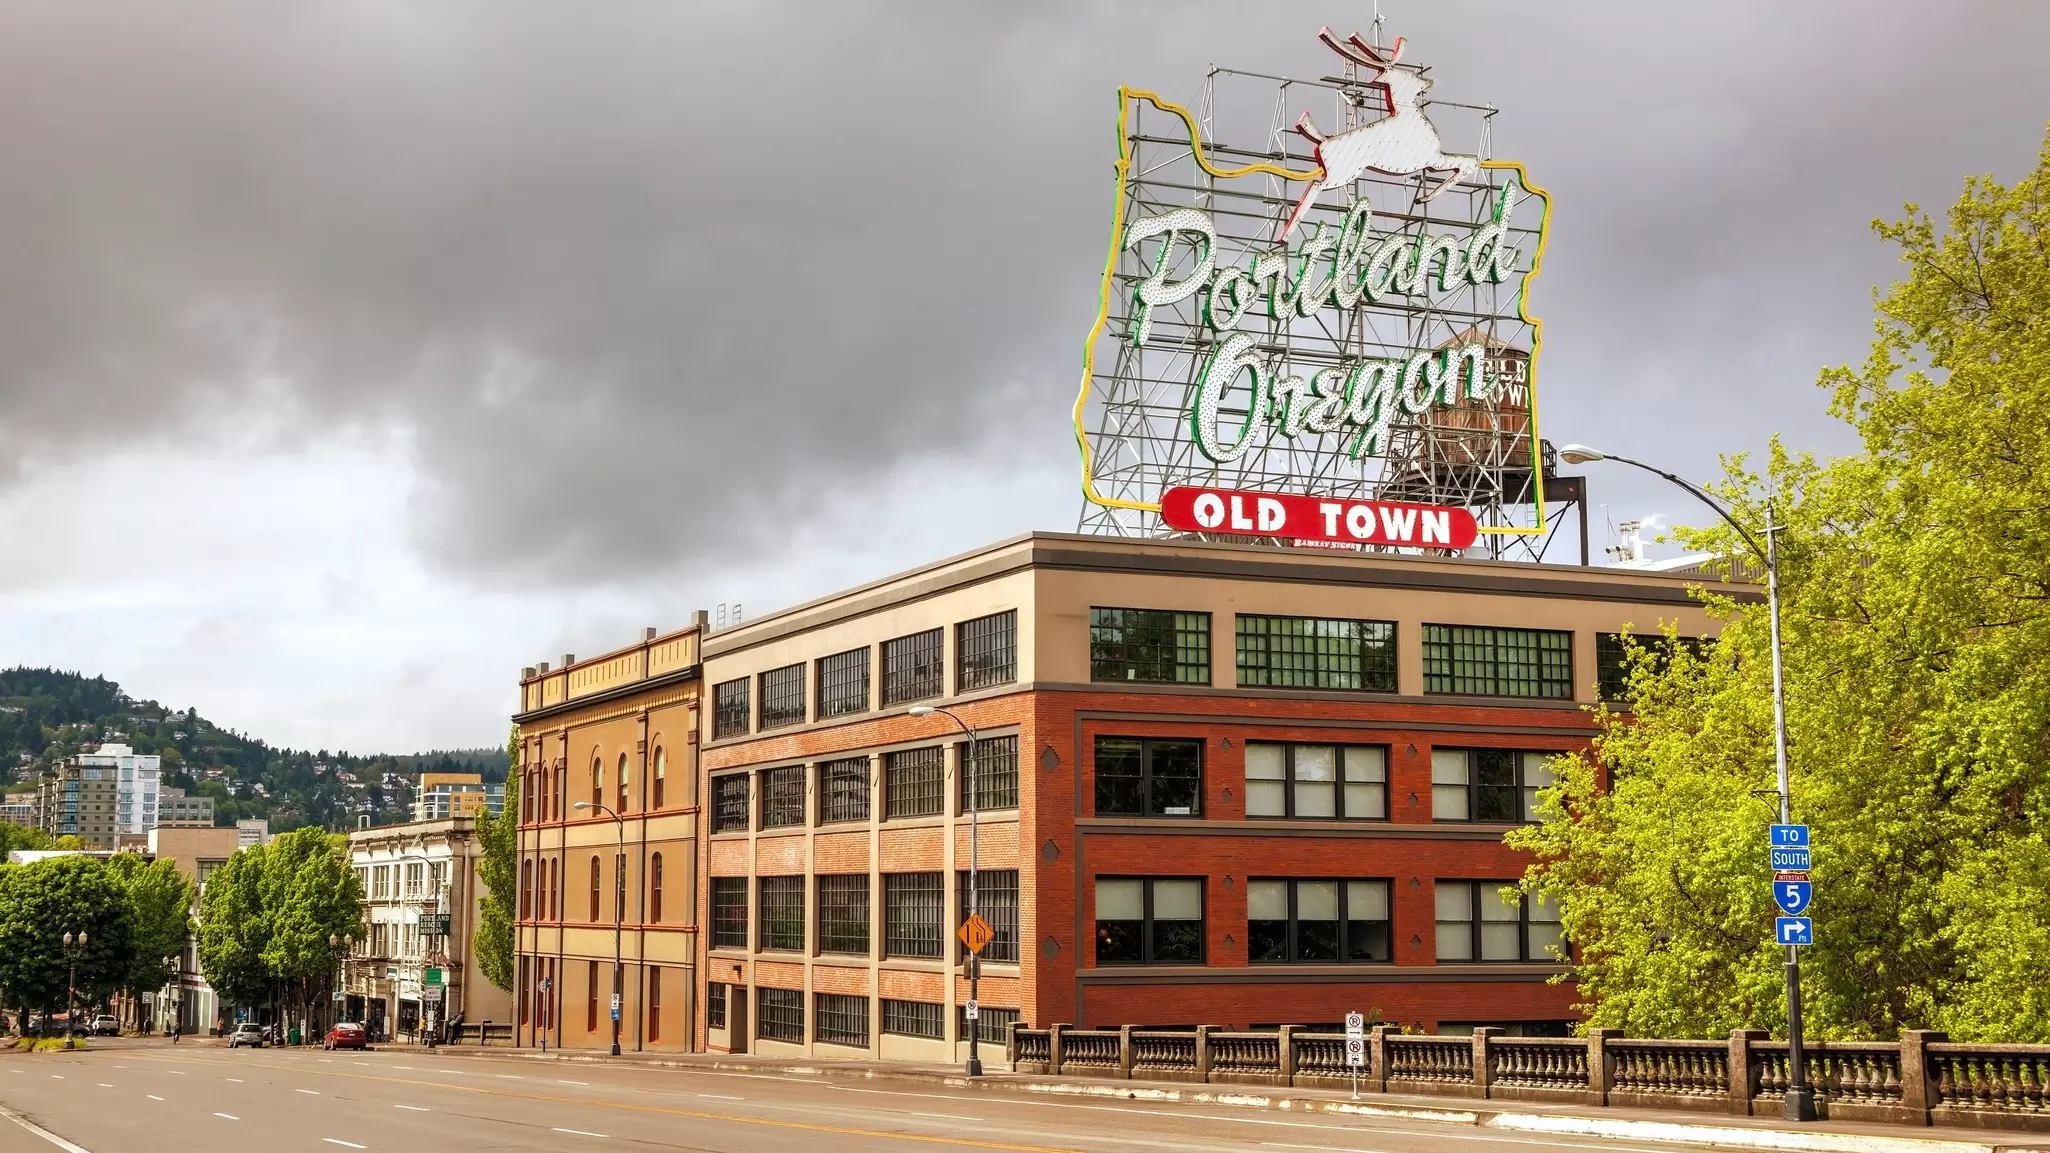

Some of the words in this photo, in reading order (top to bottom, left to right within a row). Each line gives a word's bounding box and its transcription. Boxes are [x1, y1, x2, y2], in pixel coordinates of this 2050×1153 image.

[1122, 179, 1522, 348] Portland
[1191, 333, 1497, 463] Oregon
[1193, 493, 1287, 532] OLD
[1320, 502, 1450, 544] TOWN
[1780, 829, 1799, 841] TO
[1773, 852, 1809, 866] SOUTH
[1786, 884, 1801, 908] 5
